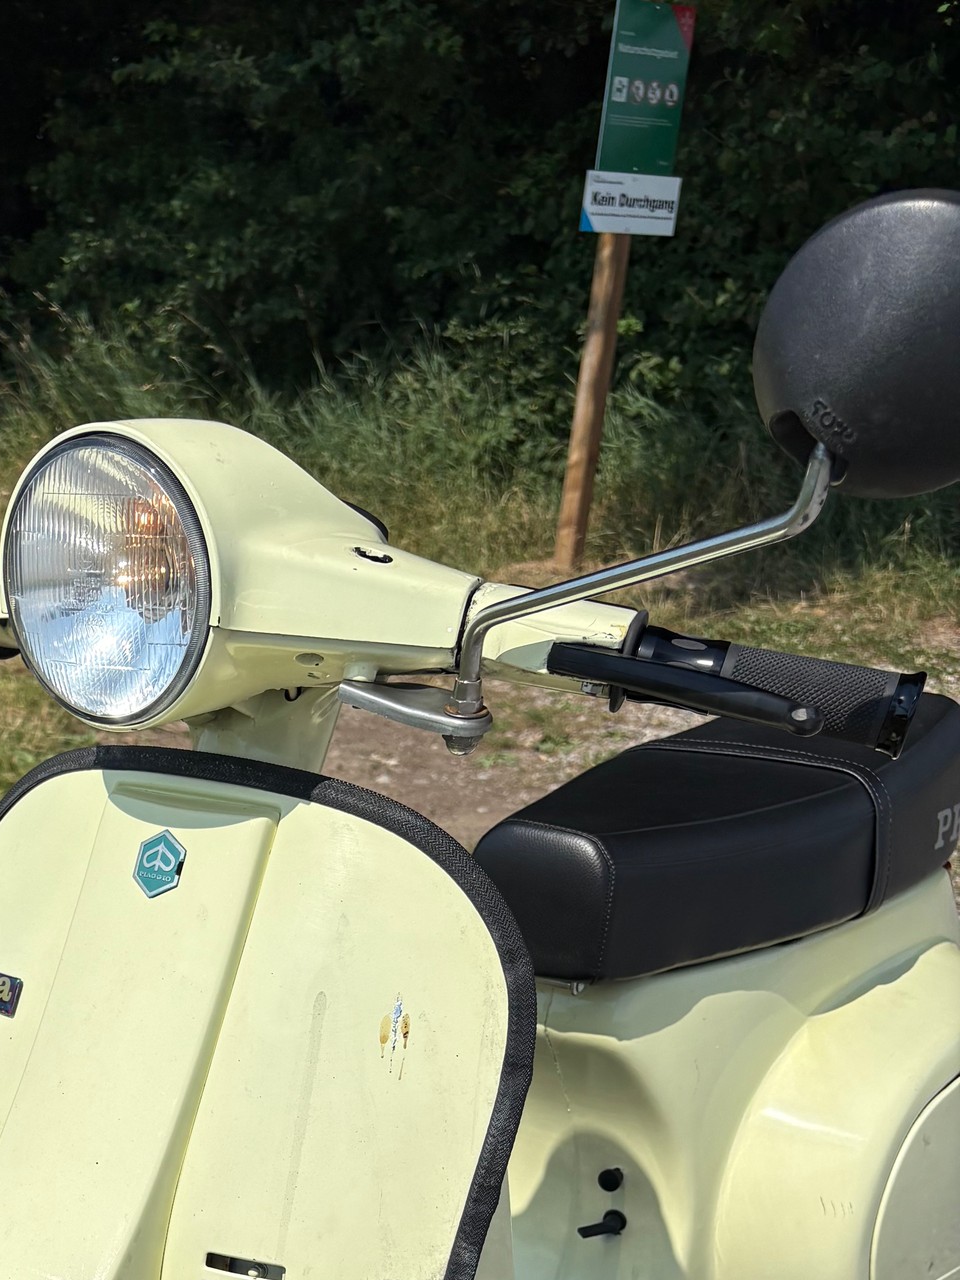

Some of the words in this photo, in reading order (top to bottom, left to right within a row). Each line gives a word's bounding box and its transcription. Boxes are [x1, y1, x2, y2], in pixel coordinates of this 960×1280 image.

[591, 191, 617, 207] Kein
[618, 193, 675, 214] Durchgang
[139, 871, 171, 882] PIAGGIO
